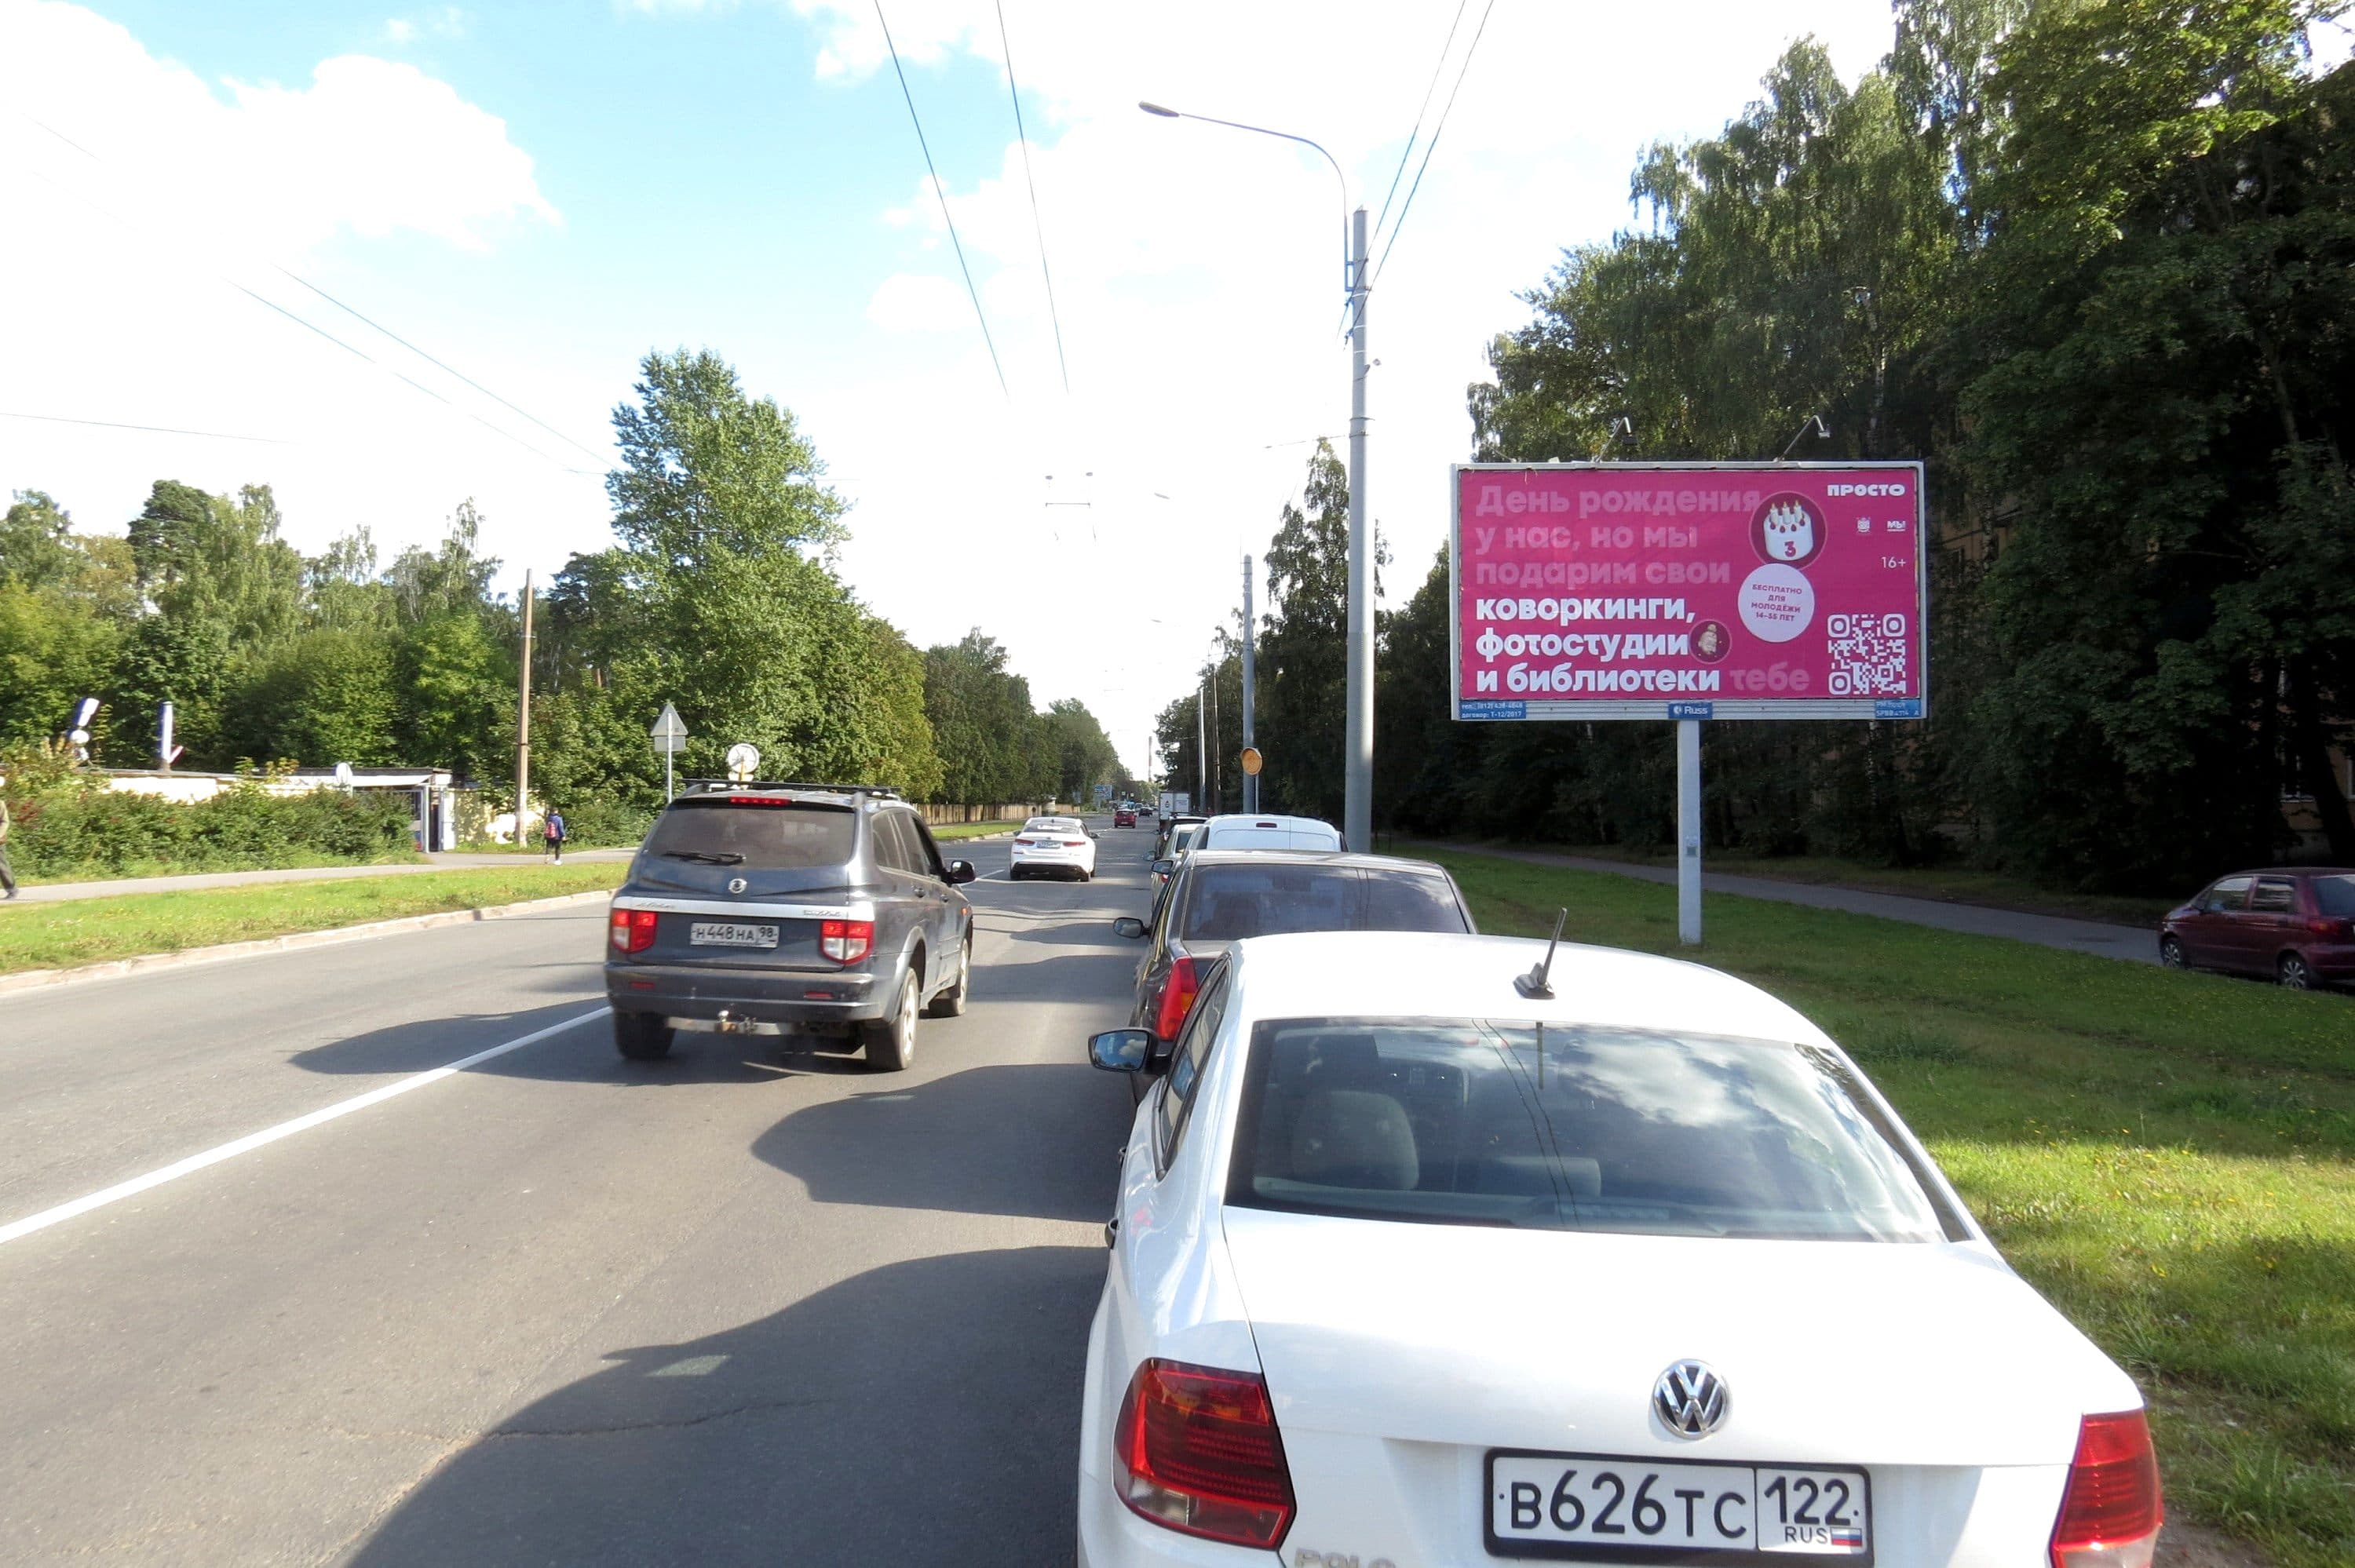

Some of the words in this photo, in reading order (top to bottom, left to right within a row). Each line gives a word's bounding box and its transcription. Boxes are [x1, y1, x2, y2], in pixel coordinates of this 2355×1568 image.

[1827, 483, 1906, 497] ПРОСТО
[1476, 485, 1570, 516] День
[1579, 490, 1761, 519] рождения
[1475, 527, 1496, 555] у
[1505, 526, 1581, 552] нас,
[1590, 527, 1634, 548] но
[1644, 527, 1698, 548] мы
[1784, 541, 1797, 557] 3
[1881, 556, 1907, 569] 16+
[1476, 562, 1637, 589] подарим
[1645, 561, 1731, 584] свои
[1751, 583, 1803, 595] БЕСПЛАТНО
[1767, 594, 1787, 603] ДЛЯ
[1476, 597, 1696, 626] коворкинги,
[1779, 614, 1795, 622] ЛЕТ
[1475, 627, 1689, 662] фотостудии
[1476, 669, 1498, 692] и
[1506, 662, 1720, 692] библиотеки
[1729, 661, 1810, 692] тебе
[1684, 706, 1708, 714] Russ
[696, 925, 754, 941] Н448НА
[759, 927, 773, 938] 98
[1510, 1469, 1747, 1539] В626ТС
[1763, 1475, 1851, 1526] 122
[1784, 1526, 1828, 1544] RUS
